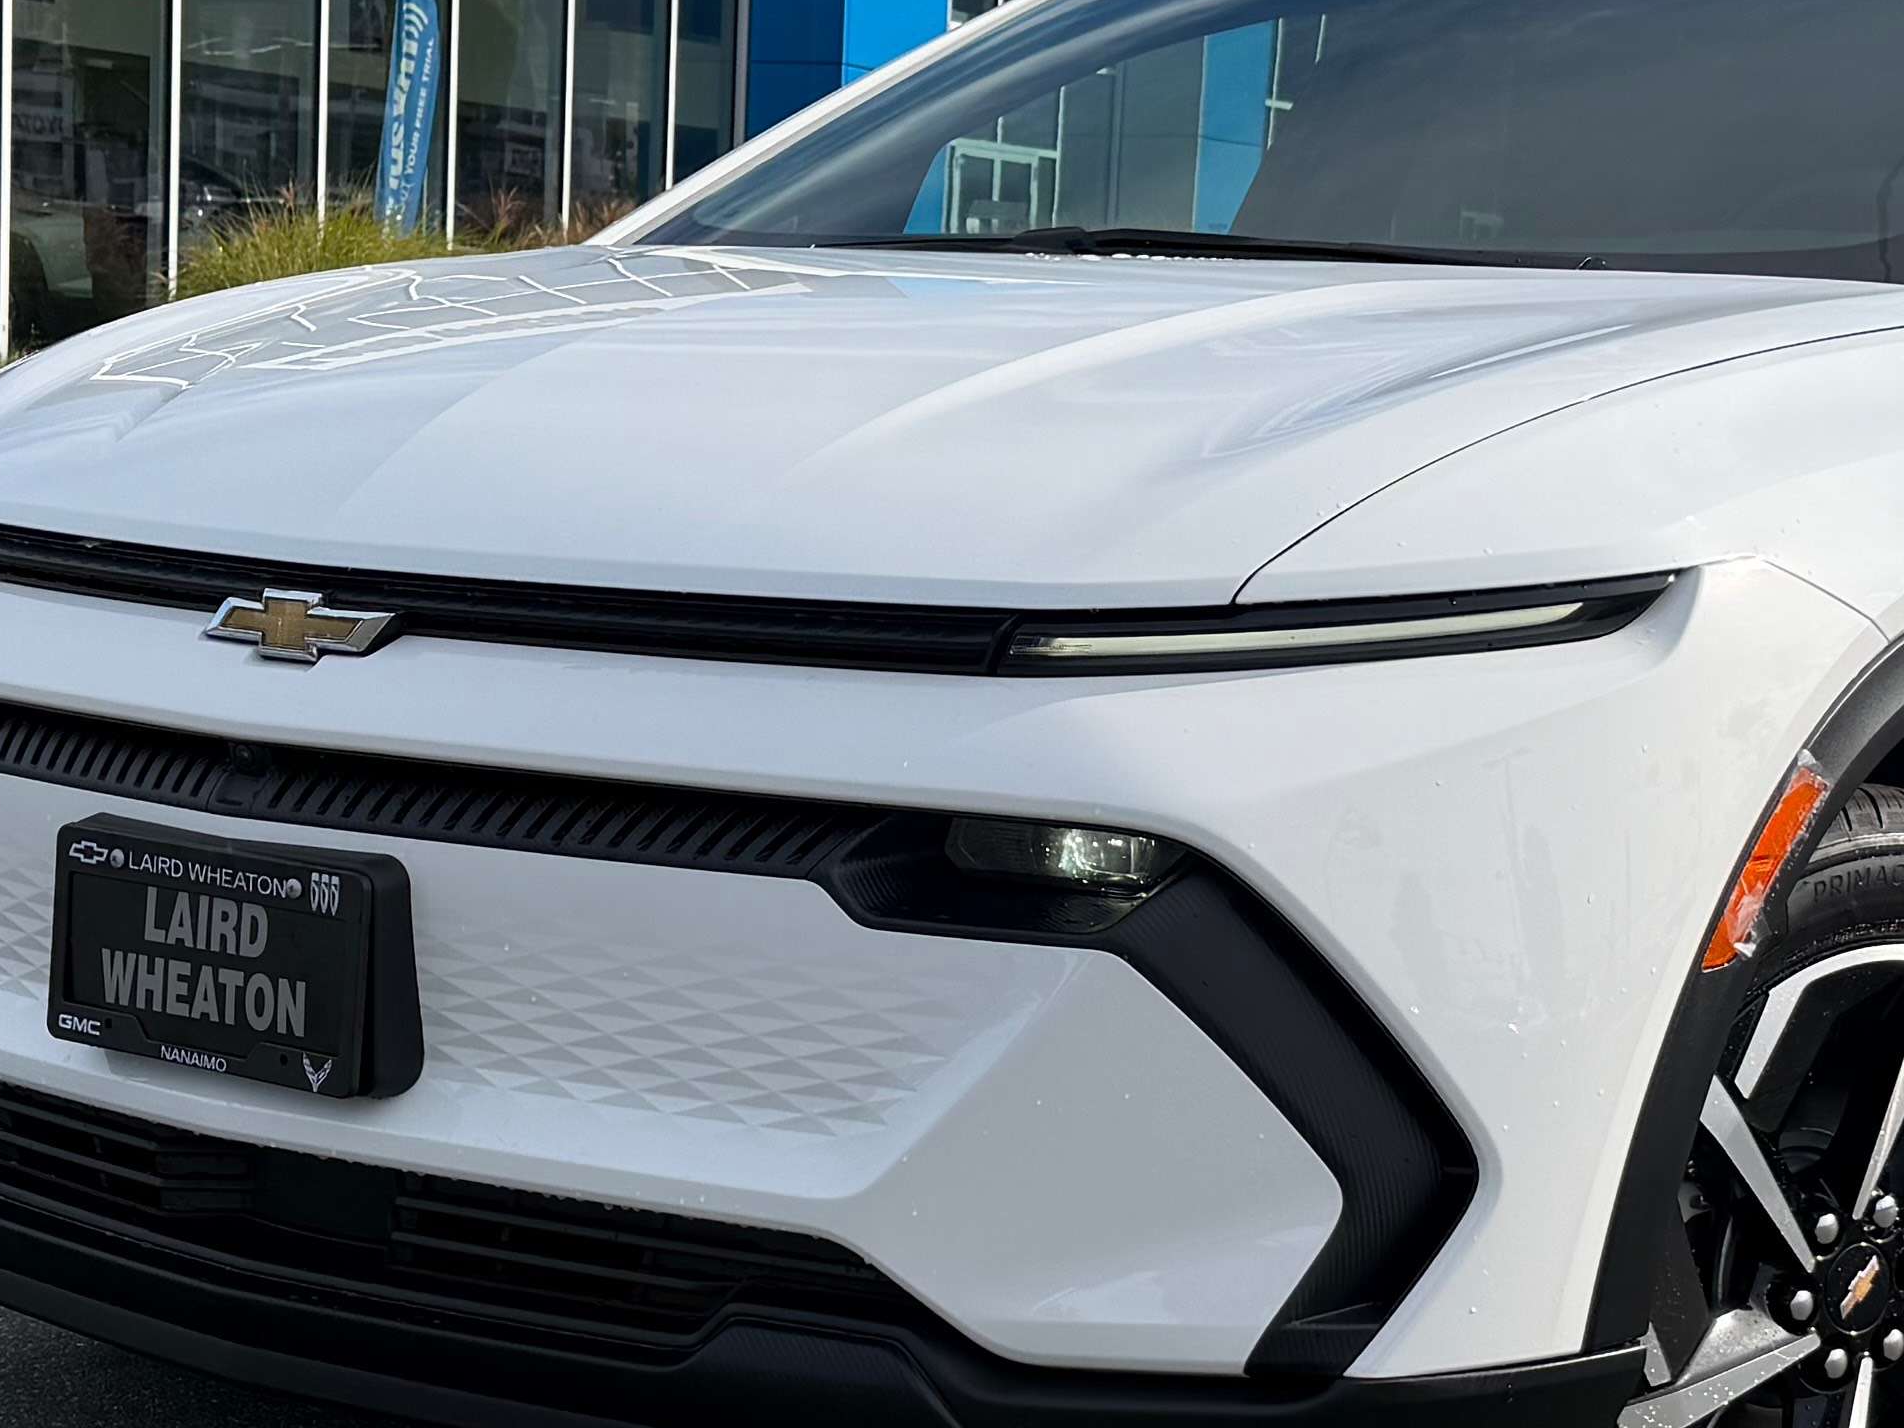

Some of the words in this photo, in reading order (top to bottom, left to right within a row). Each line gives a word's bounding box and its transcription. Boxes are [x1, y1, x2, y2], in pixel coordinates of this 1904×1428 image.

[404, 132, 421, 175] YOUR
[415, 85, 427, 128] FREE
[421, 36, 435, 83] TRIAL
[128, 850, 184, 879] LAIRD
[188, 862, 287, 899] WHEATON
[143, 885, 269, 958] LAIRD
[101, 948, 307, 1038] WHEATON
[58, 1012, 102, 1036] GMC
[160, 1044, 228, 1074] NANAIMO
